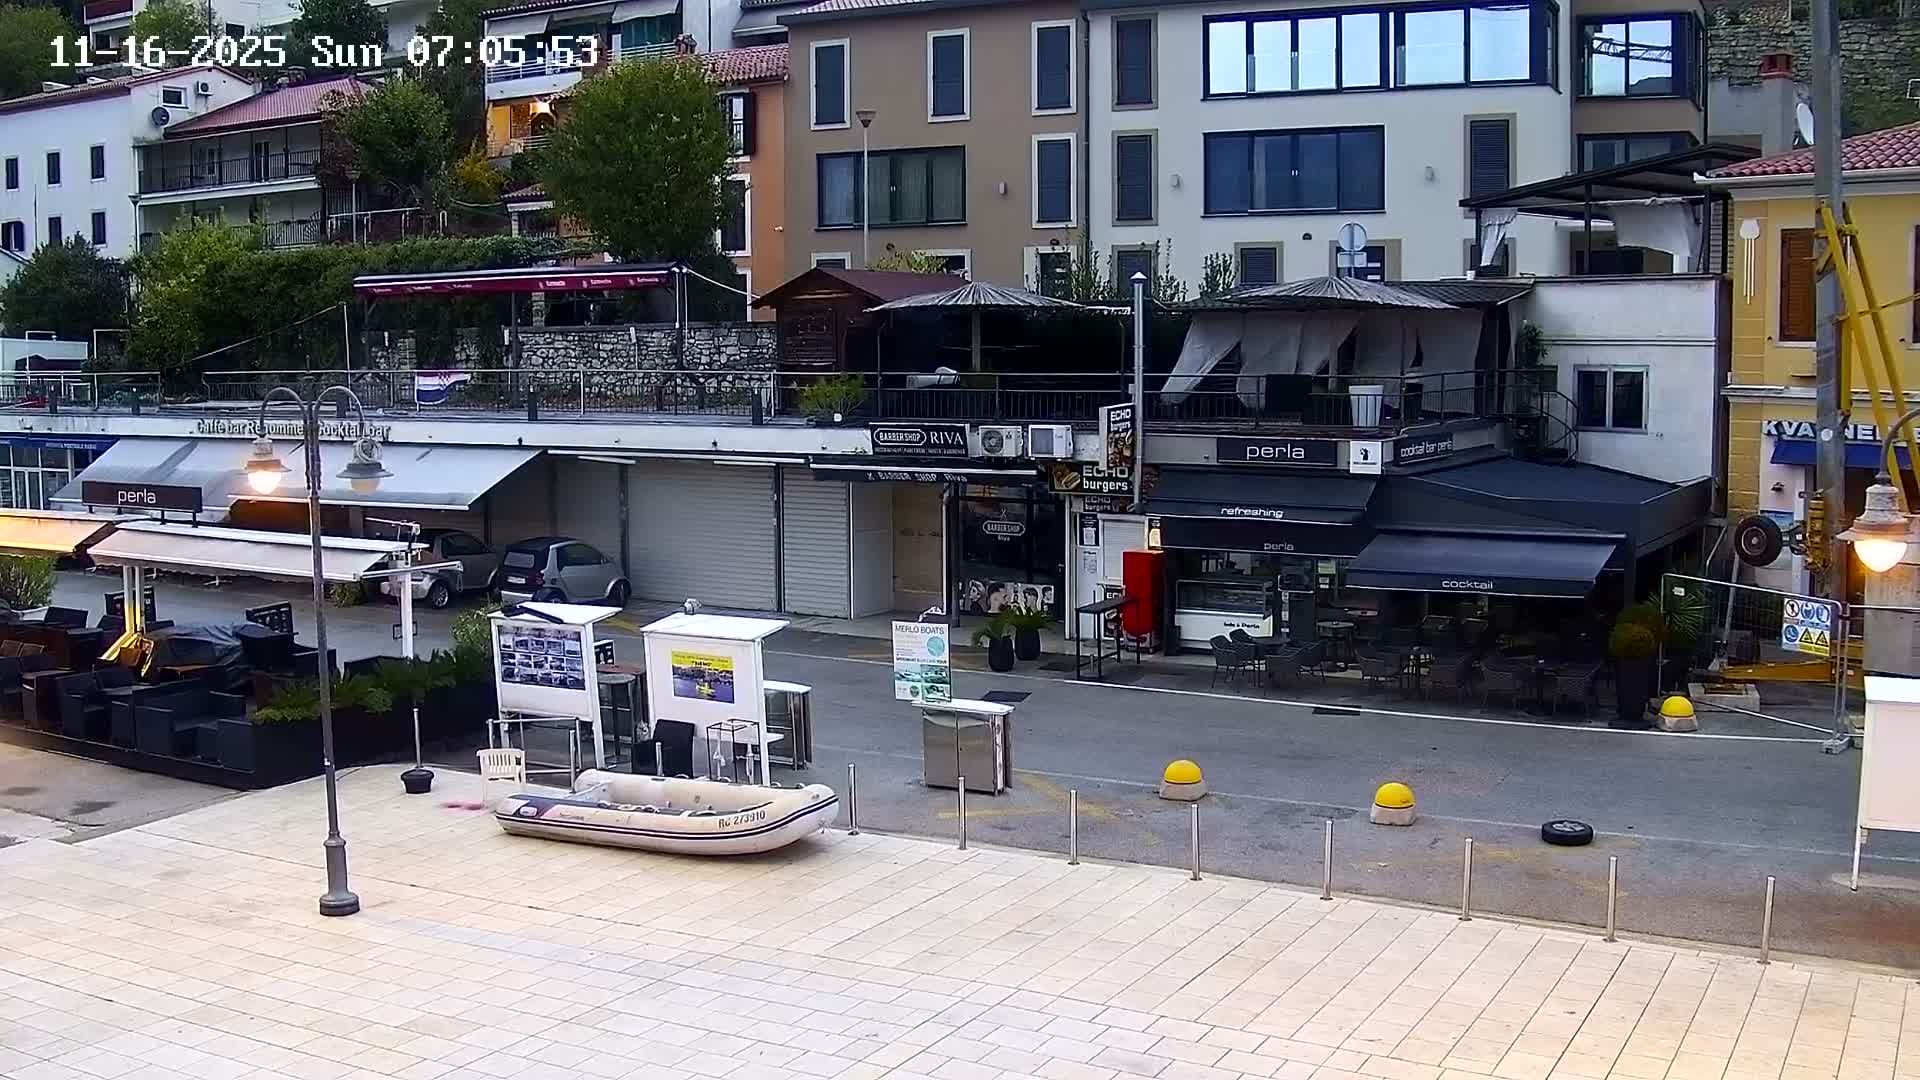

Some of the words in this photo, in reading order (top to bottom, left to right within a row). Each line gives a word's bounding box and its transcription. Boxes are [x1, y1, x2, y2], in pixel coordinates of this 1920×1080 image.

[1110, 408, 1132, 421] ECHO
[929, 431, 965, 446] RIVA
[1246, 443, 1305, 461] perla
[1082, 464, 1129, 479] ECHO
[1082, 477, 1128, 492] burgers
[118, 488, 157, 505] perla
[1220, 507, 1284, 519] refreshing
[1263, 542, 1295, 552] perla
[1441, 580, 1494, 590] cocktail
[895, 624, 920, 634] MERLO
[920, 626, 945, 635] BOATS
